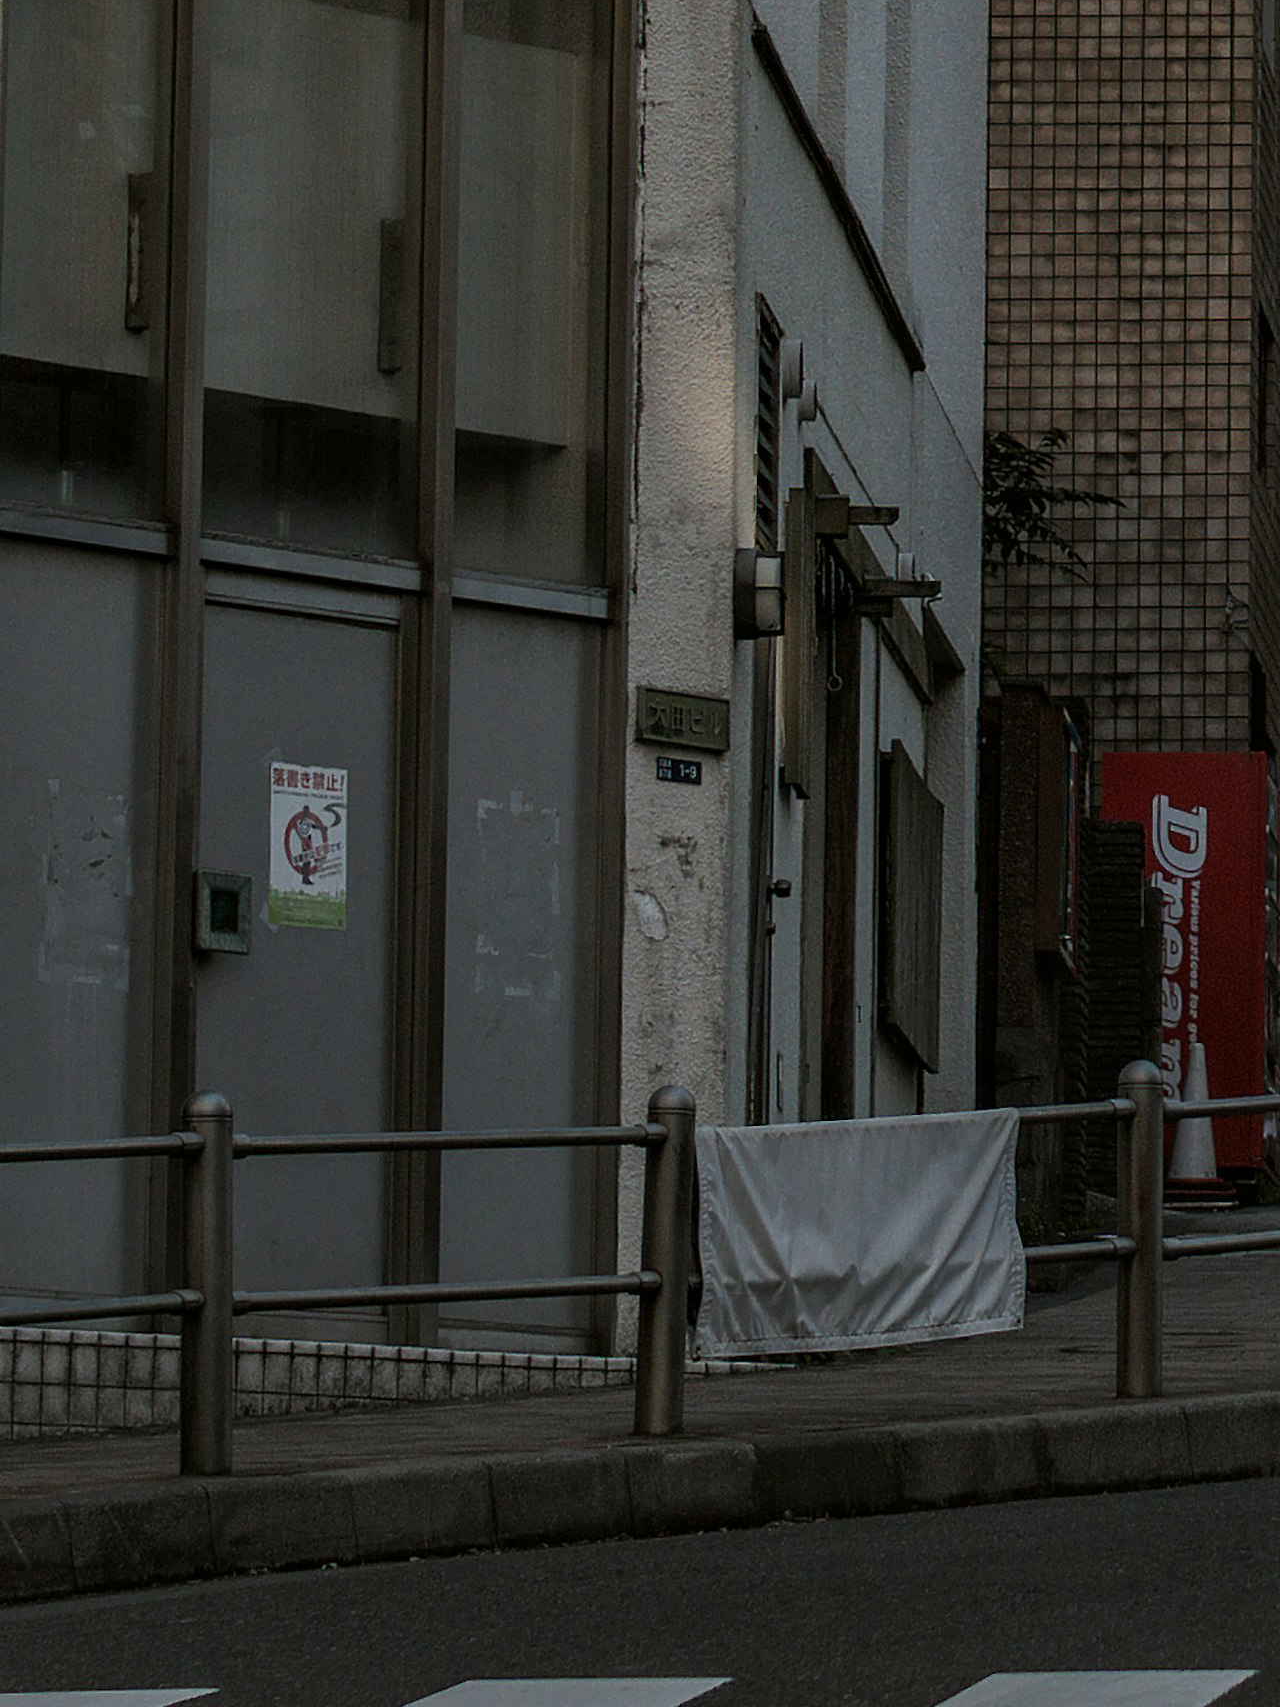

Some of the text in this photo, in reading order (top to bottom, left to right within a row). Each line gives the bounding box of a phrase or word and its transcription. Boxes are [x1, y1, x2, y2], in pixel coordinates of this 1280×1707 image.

[272, 767, 345, 792] 落書き禁止!
